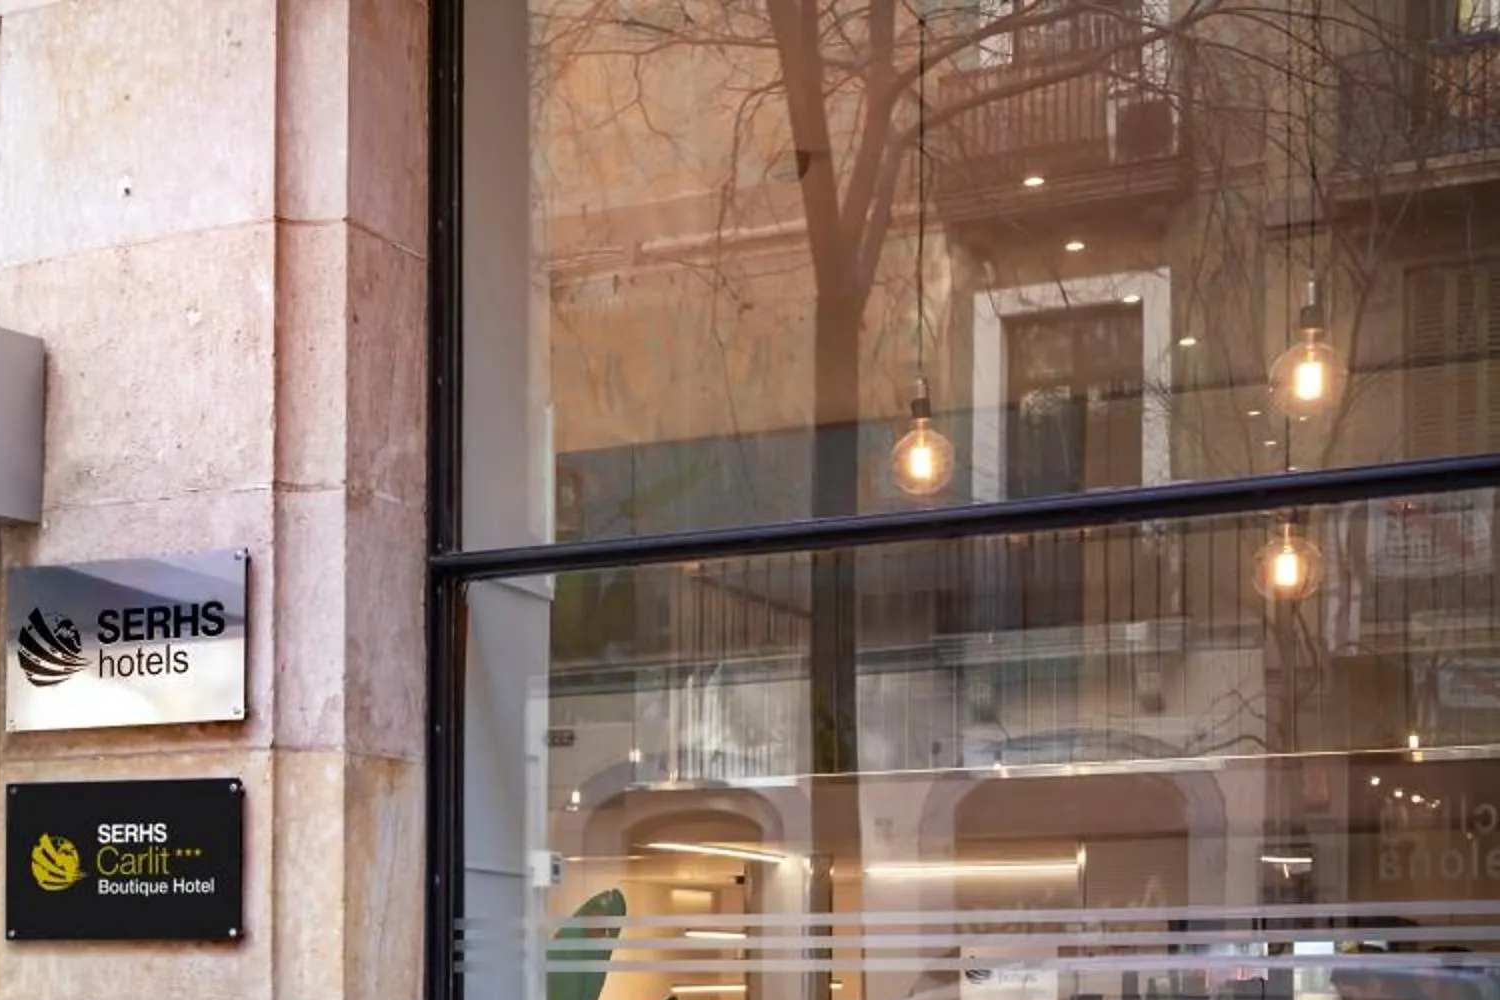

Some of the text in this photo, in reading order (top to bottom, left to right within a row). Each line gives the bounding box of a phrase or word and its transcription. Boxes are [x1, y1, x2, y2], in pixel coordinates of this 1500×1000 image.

[97, 601, 226, 644] SERHS
[99, 645, 189, 679] hotels
[97, 823, 168, 844] SERHS
[96, 846, 170, 876] Carlit
[98, 878, 215, 897] Boutique Hotel
